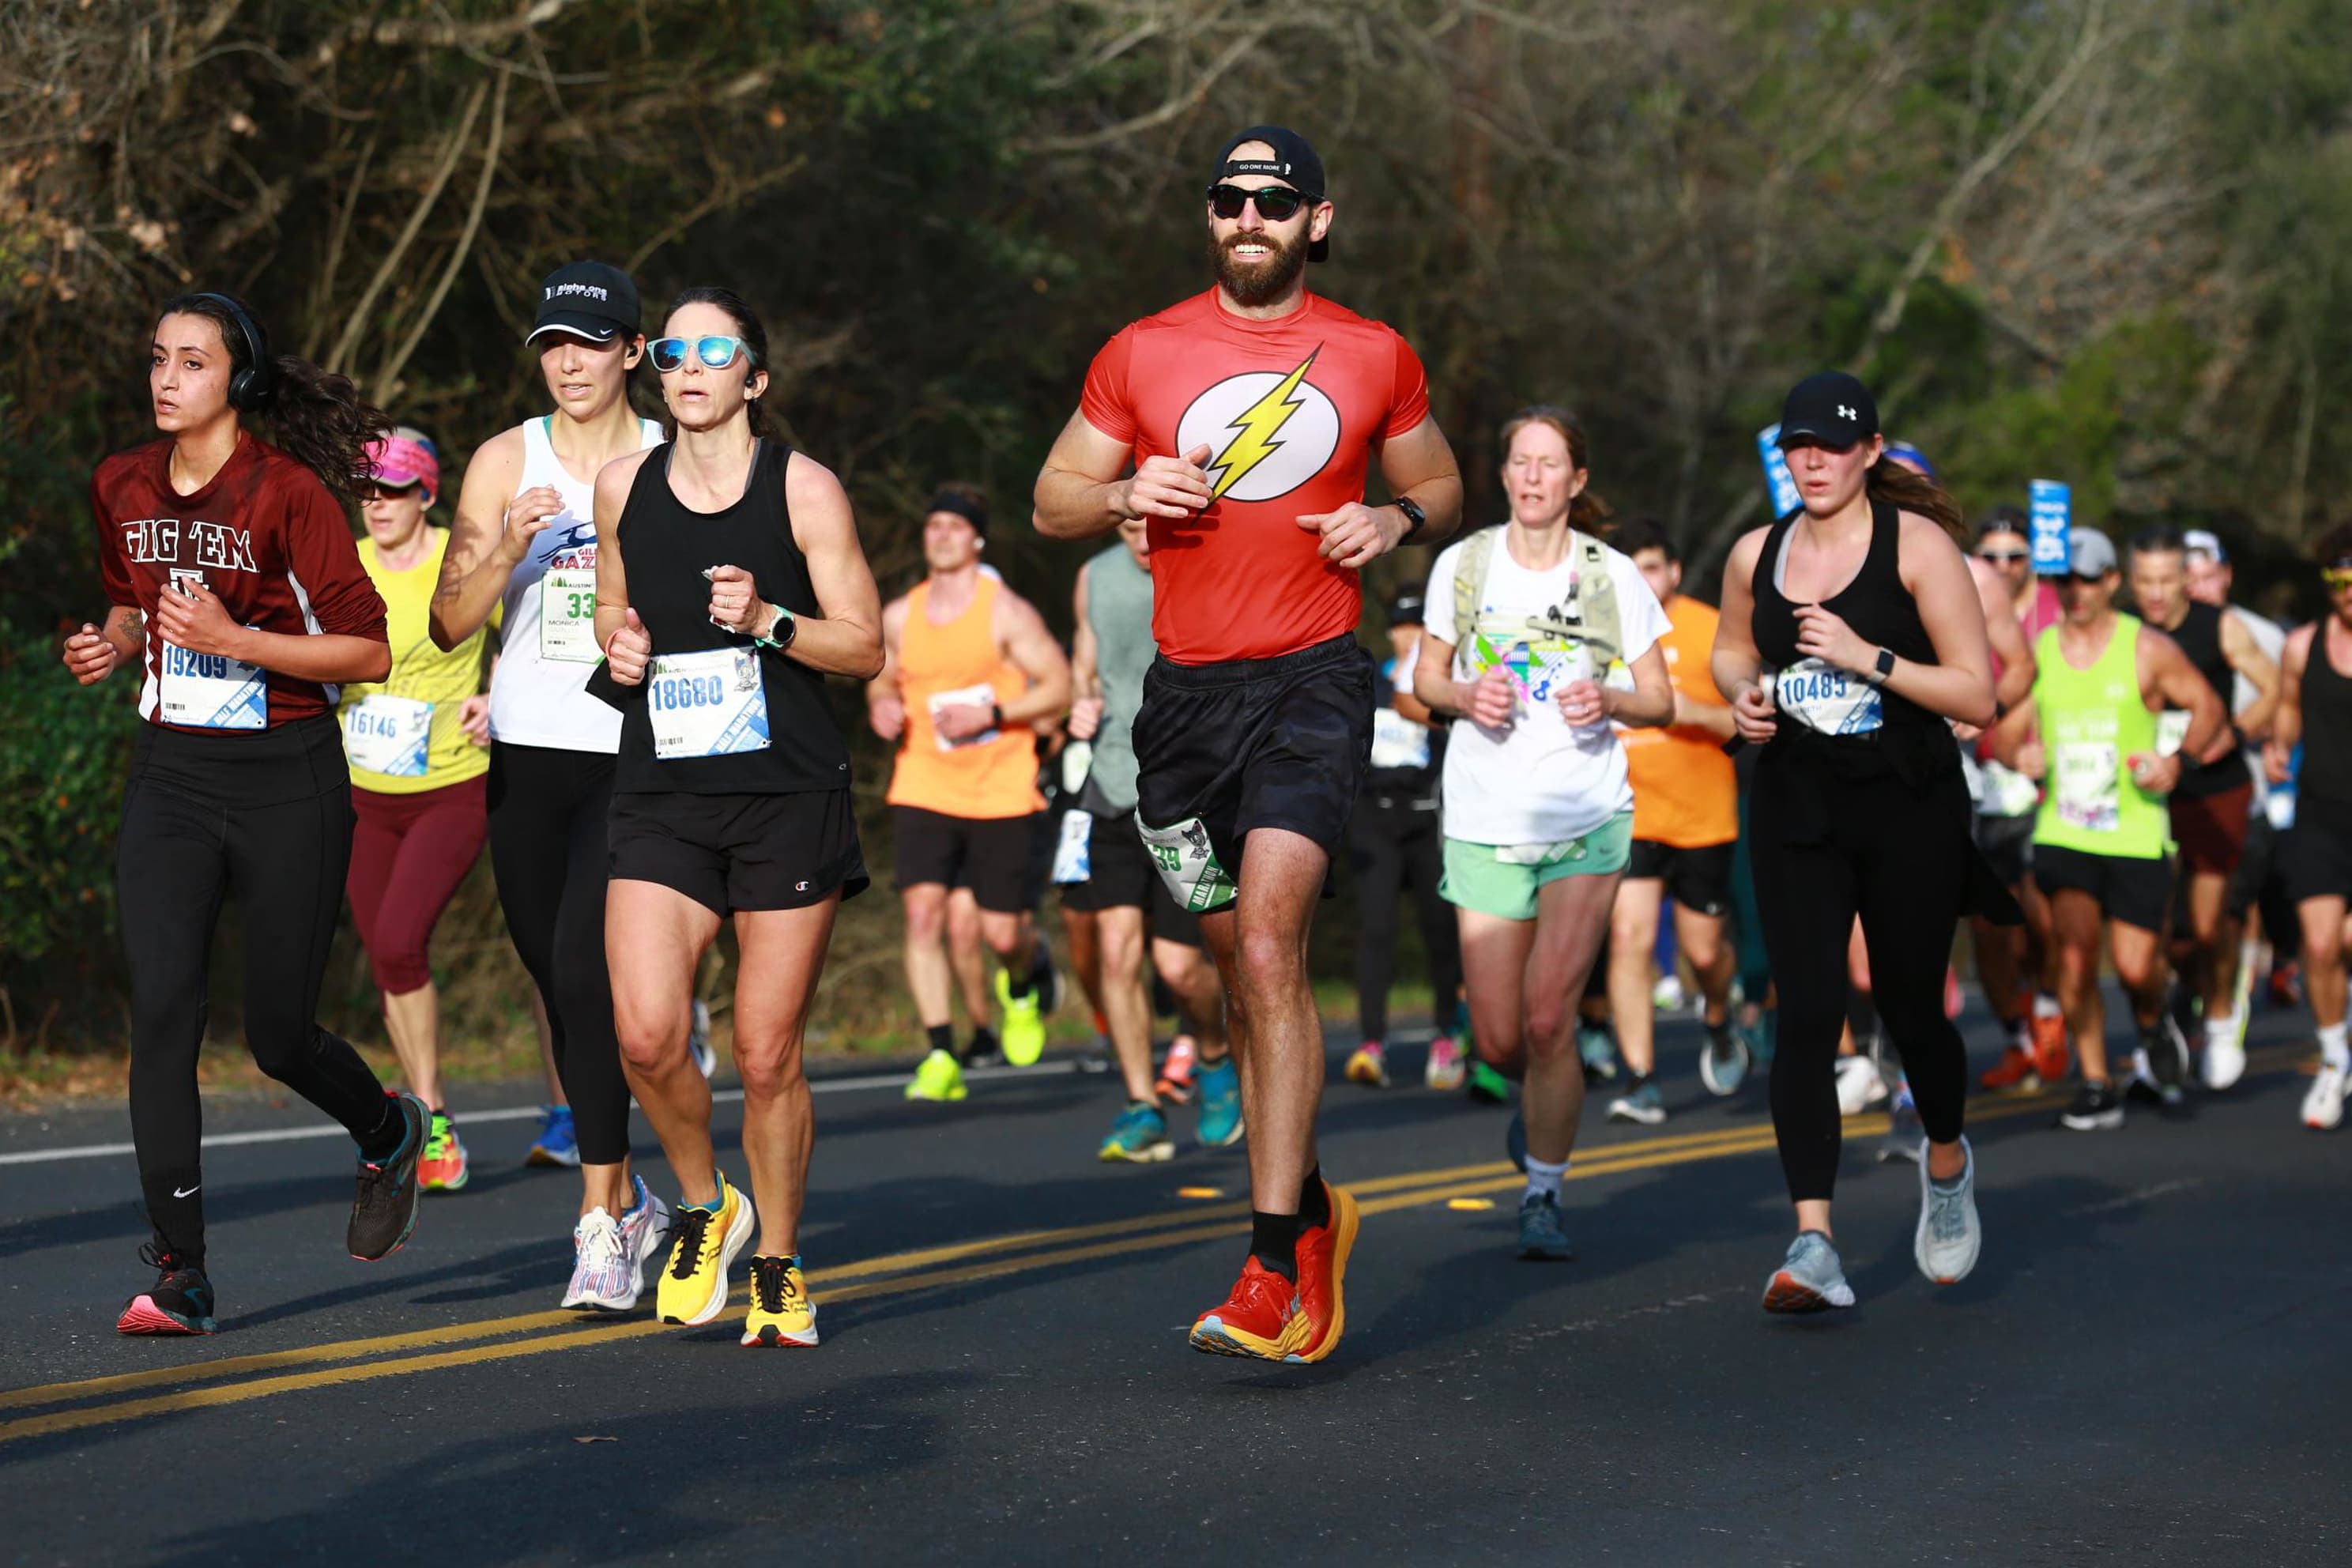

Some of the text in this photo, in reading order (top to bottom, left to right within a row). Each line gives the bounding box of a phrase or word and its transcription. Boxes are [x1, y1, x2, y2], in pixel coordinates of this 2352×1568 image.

[121, 519, 179, 563] GIG
[551, 555, 597, 570] GAZ
[166, 644, 228, 680] 19209
[652, 675, 724, 711] 18680
[1783, 672, 1848, 706] 10485
[350, 711, 397, 738] 16146
[715, 696, 763, 752] HALF MARATHON
[1191, 865, 1219, 906] MARATHON
